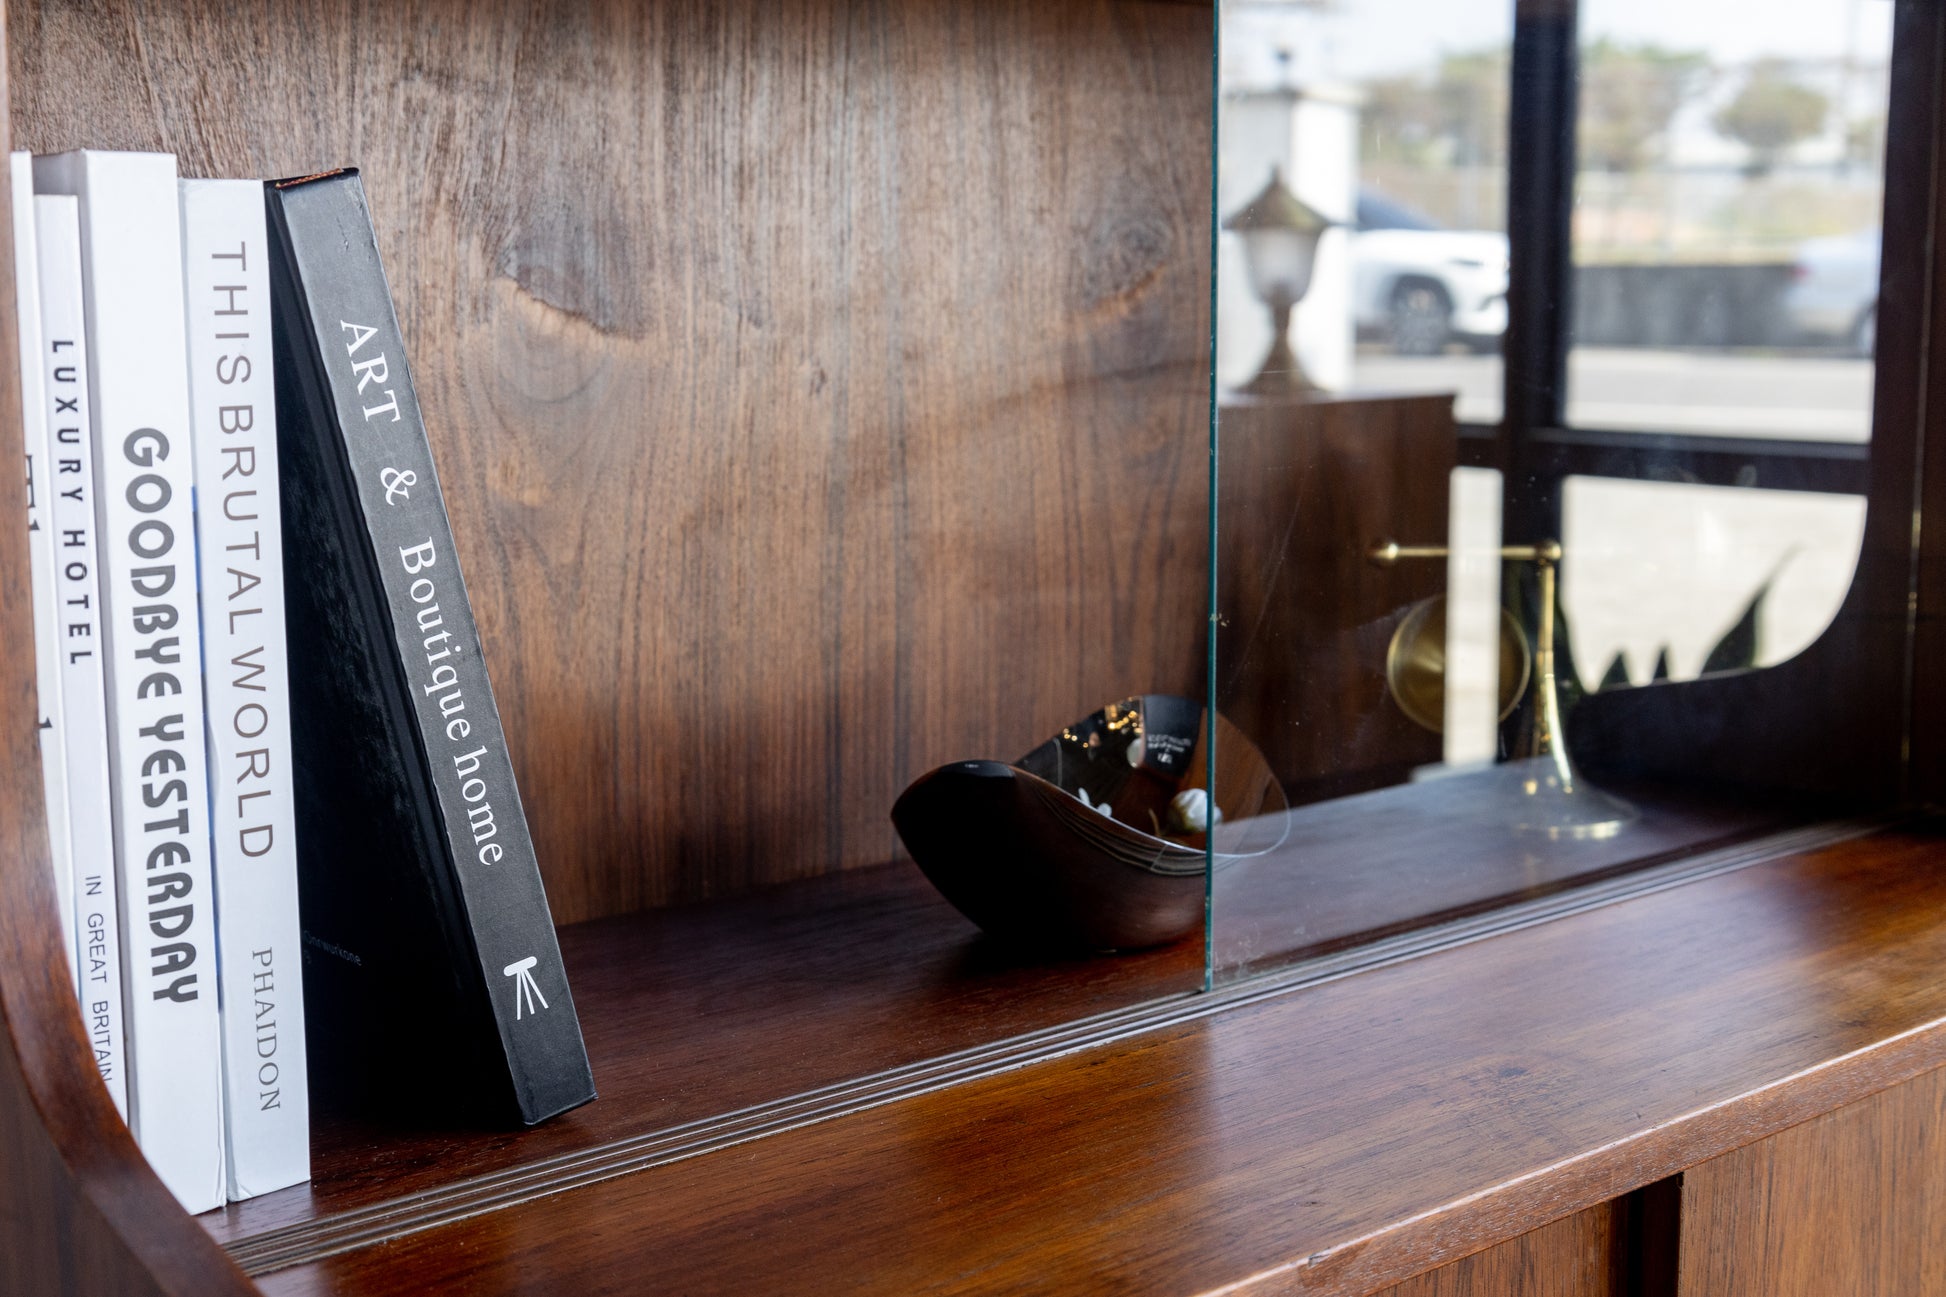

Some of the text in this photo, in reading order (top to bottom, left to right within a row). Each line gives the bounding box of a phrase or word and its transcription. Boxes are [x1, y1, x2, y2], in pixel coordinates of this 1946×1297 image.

[52, 340, 92, 665] LUXURY HOTEL
[123, 427, 199, 1003] GOODBYE YESTERDAY
[211, 241, 274, 858] THIS BRUTAL WORLD
[340, 319, 503, 866] ART & Boutique home
[85, 875, 113, 1082] IN GREAT BRITAIN
[252, 948, 281, 1112] PHAIDON
